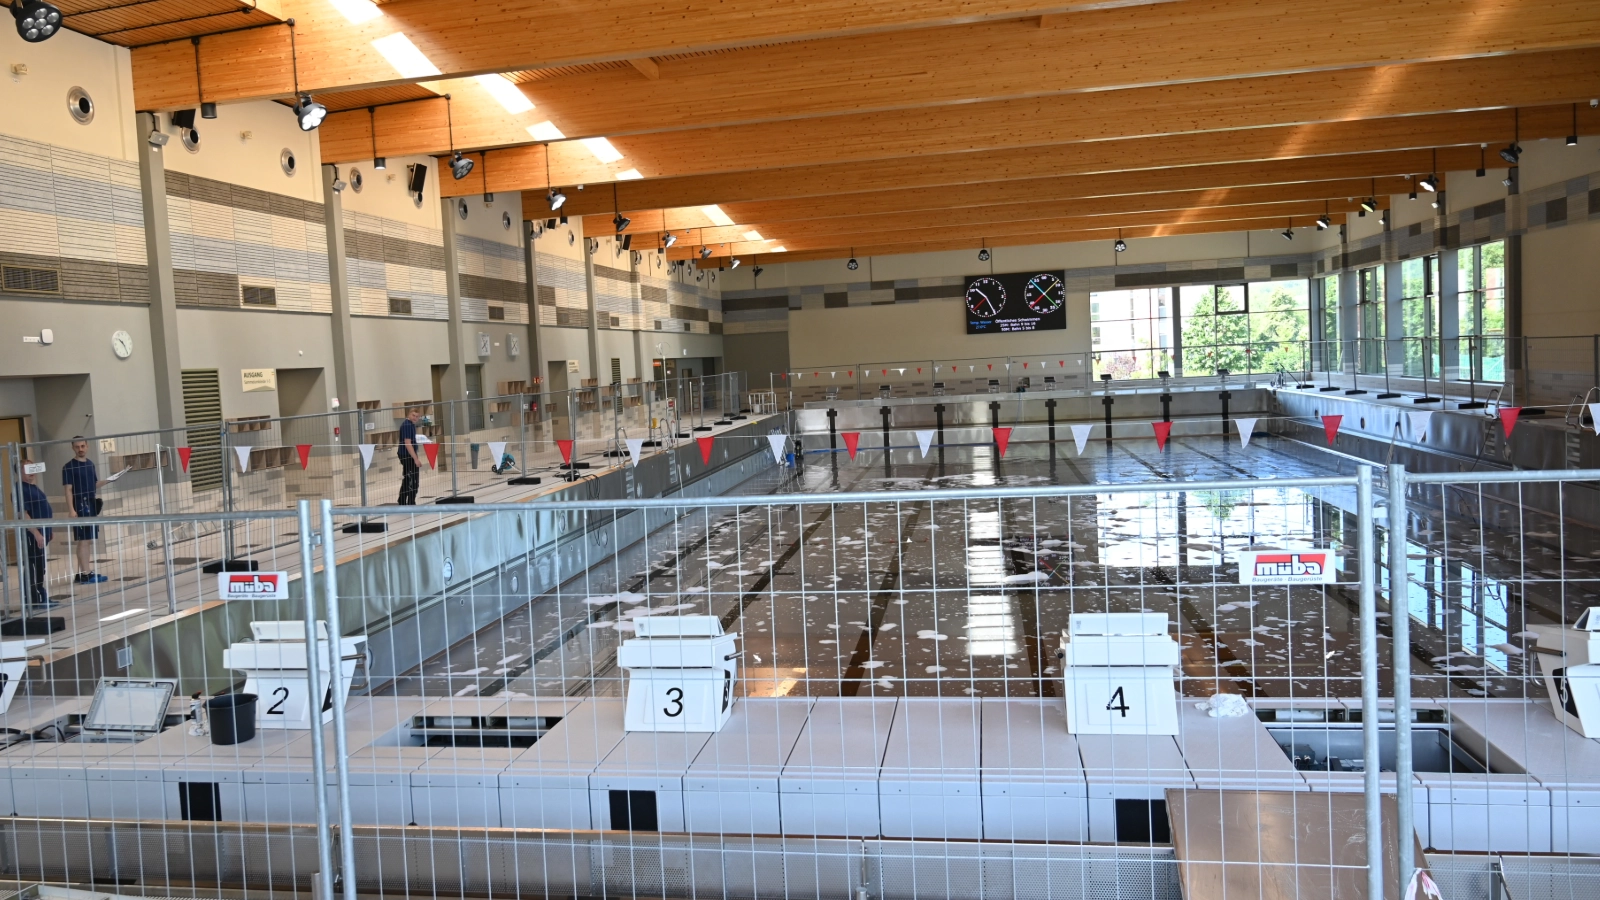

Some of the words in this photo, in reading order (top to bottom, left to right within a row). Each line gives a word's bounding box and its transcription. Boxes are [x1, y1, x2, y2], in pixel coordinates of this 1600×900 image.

[1256, 554, 1322, 576] müba
[229, 575, 276, 592] müba
[266, 686, 289, 714] 2
[663, 687, 684, 717] 3
[1106, 686, 1130, 717] 4
